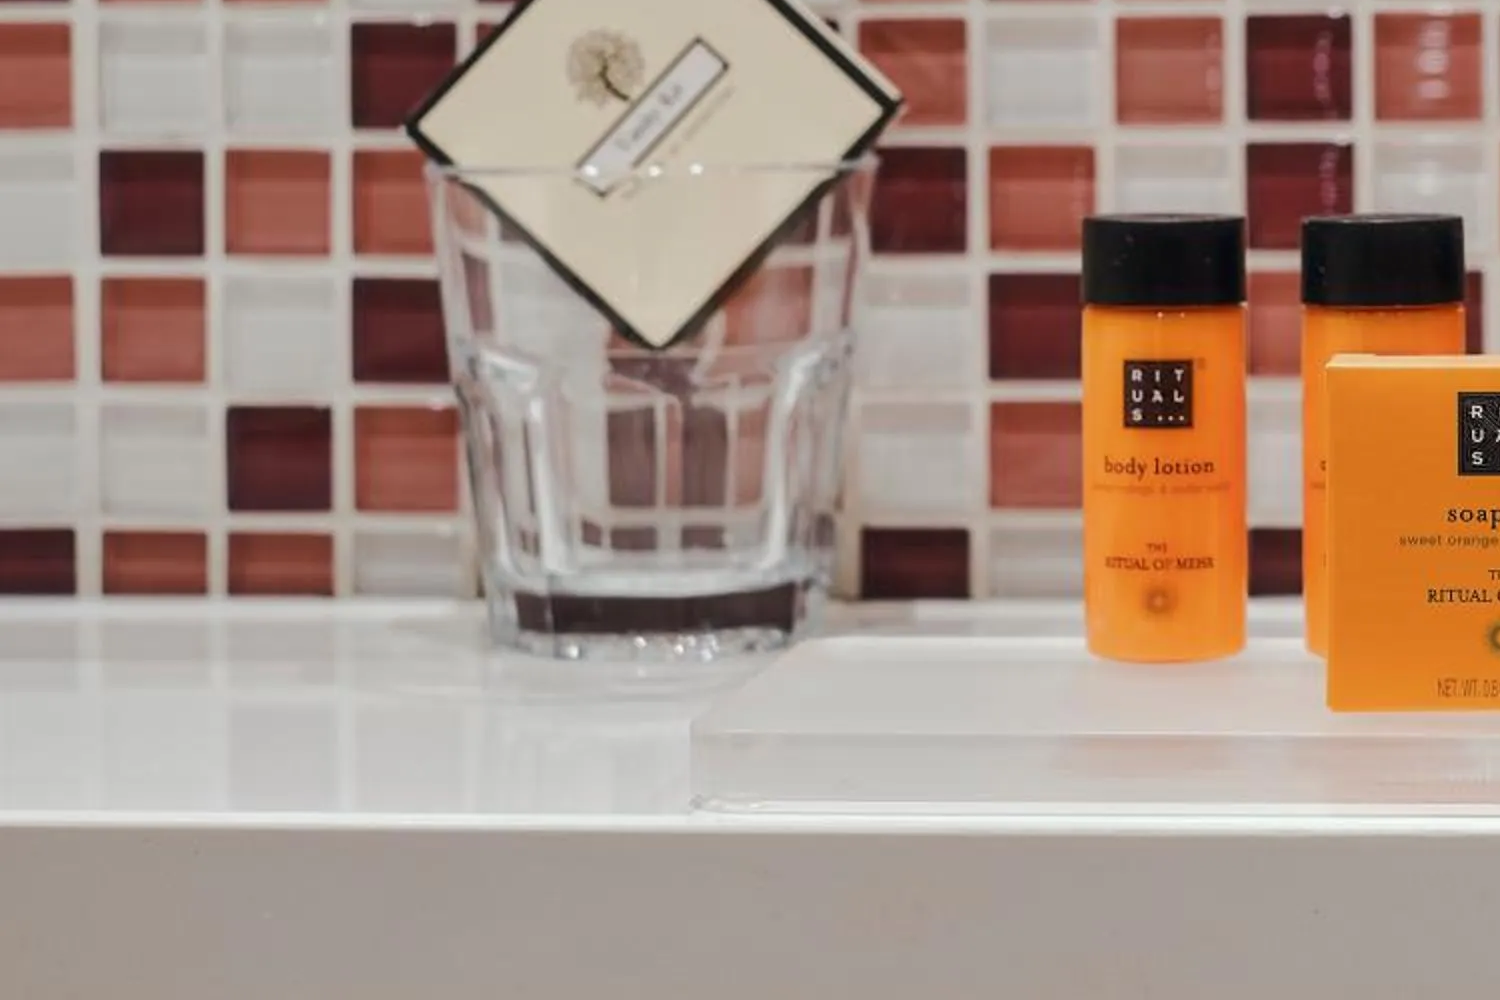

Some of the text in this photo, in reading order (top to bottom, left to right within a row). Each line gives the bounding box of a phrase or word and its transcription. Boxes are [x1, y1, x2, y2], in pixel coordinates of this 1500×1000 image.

[1104, 455, 1215, 482] body lotion
[1399, 535, 1443, 547] sweet
[1447, 535, 1499, 550] orange
[1427, 588, 1493, 604] RITUAL
